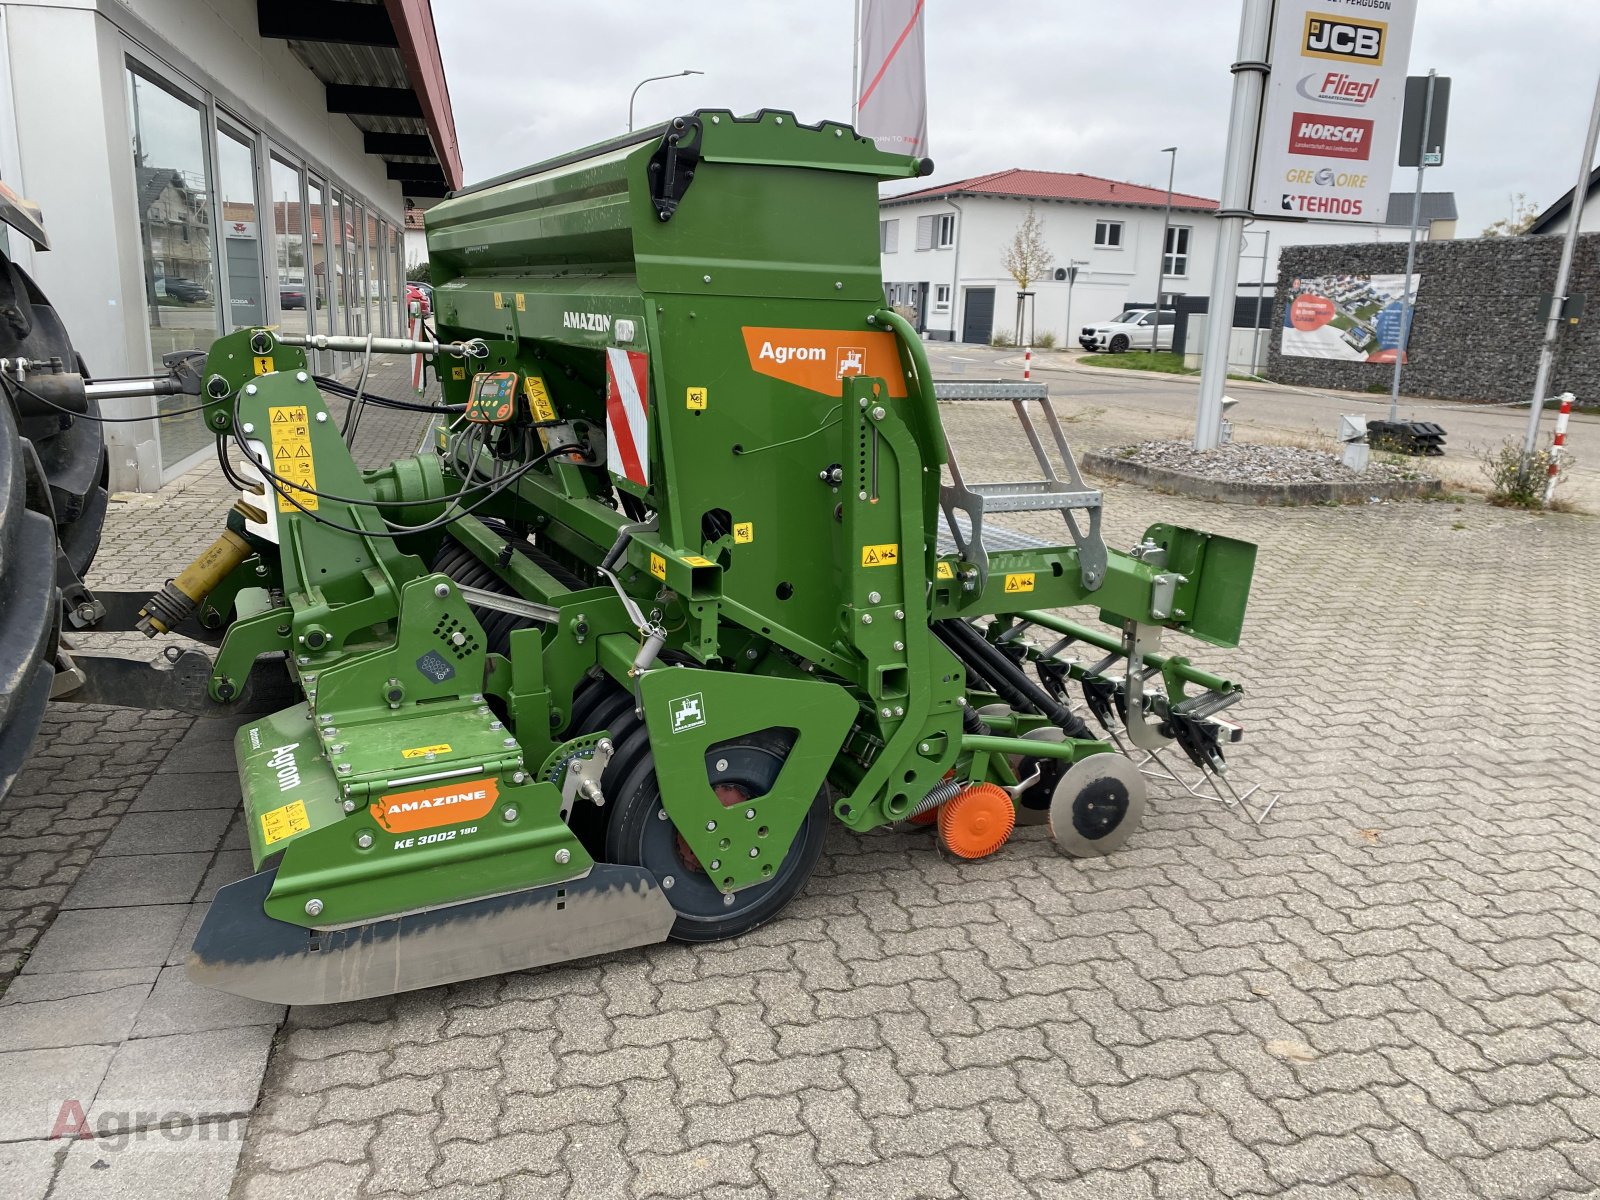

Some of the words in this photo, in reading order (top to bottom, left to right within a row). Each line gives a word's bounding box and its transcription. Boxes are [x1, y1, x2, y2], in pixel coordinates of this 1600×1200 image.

[1309, 23, 1380, 56] JCB
[1320, 72, 1380, 103] Fliegl
[1298, 122, 1364, 143] HORSCH
[1298, 195, 1362, 215] TEHNOS
[563, 311, 612, 332] AMAZON
[759, 342, 826, 364] Agrom
[267, 742, 301, 792] Agrom
[388, 790, 486, 815] AMAZONE
[394, 838, 415, 849] KE
[417, 830, 457, 846] 3002
